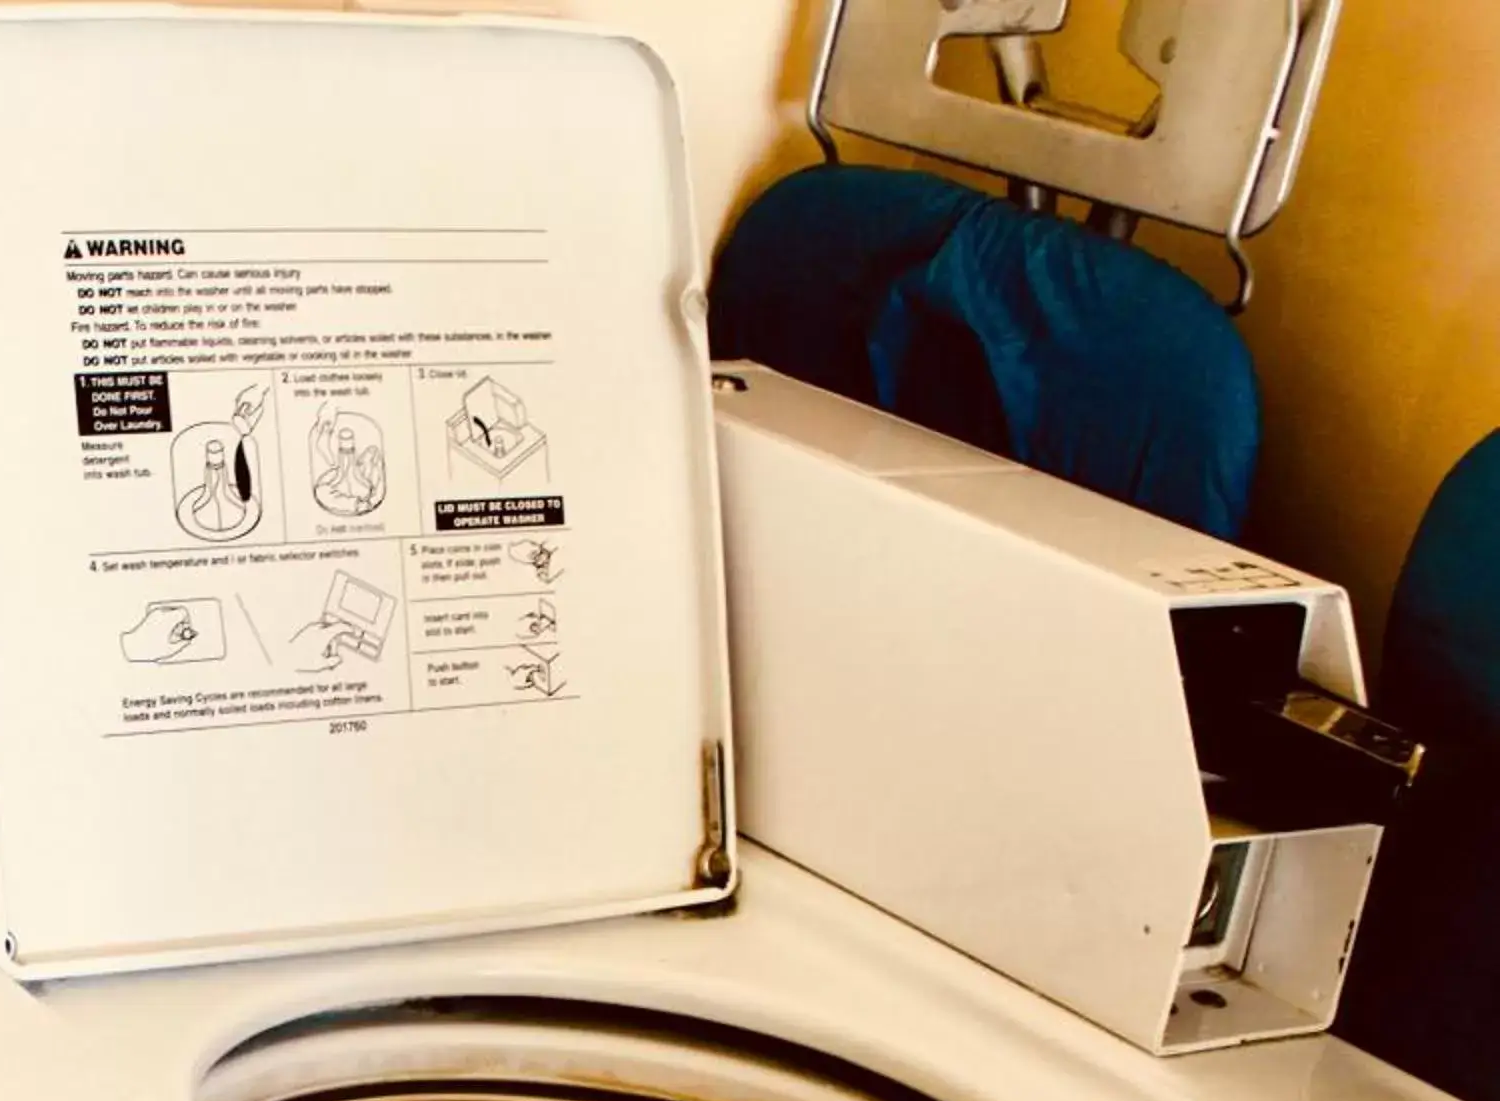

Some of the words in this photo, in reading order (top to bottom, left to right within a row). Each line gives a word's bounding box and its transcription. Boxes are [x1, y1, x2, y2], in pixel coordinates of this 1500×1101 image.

[88, 239, 184, 256] WARNING
[66, 271, 104, 281] Moving
[108, 271, 134, 282] parts
[177, 268, 198, 279] Can
[201, 270, 230, 279] cause
[234, 269, 270, 279] serious
[78, 288, 94, 298] DO
[98, 287, 123, 297] NOT
[78, 305, 95, 315] DO
[100, 304, 124, 314] NOT
[70, 321, 90, 332] Fire
[135, 319, 147, 331] To
[150, 321, 184, 330] reduce
[188, 319, 204, 329] the
[208, 320, 226, 329] risk
[229, 318, 239, 328] of
[82, 339, 98, 349] DO
[103, 338, 127, 349] NOT
[84, 355, 100, 366] DO
[104, 355, 128, 365] NOT
[92, 376, 114, 387] THIS
[117, 375, 145, 386] MUST
[149, 374, 162, 386] BE
[92, 391, 121, 403] DONE
[124, 389, 156, 401] FIRST.
[92, 406, 107, 417] Do
[110, 406, 127, 416] Not
[129, 404, 152, 415] Pour
[94, 420, 118, 431] Over
[438, 503, 454, 514] LID
[457, 502, 485, 512] MUST
[489, 501, 502, 511] BE
[505, 499, 544, 510] CLOSED
[548, 498, 562, 508] TO
[454, 515, 500, 527] OPERATE
[503, 513, 544, 524] WASHER
[122, 696, 156, 710] Energy
[160, 693, 193, 706] Saving
[195, 690, 227, 703] Cycles
[230, 691, 245, 700] are
[248, 685, 315, 698] recommended
[316, 683, 329, 693] for
[332, 682, 343, 692] all
[344, 681, 367, 693] large
